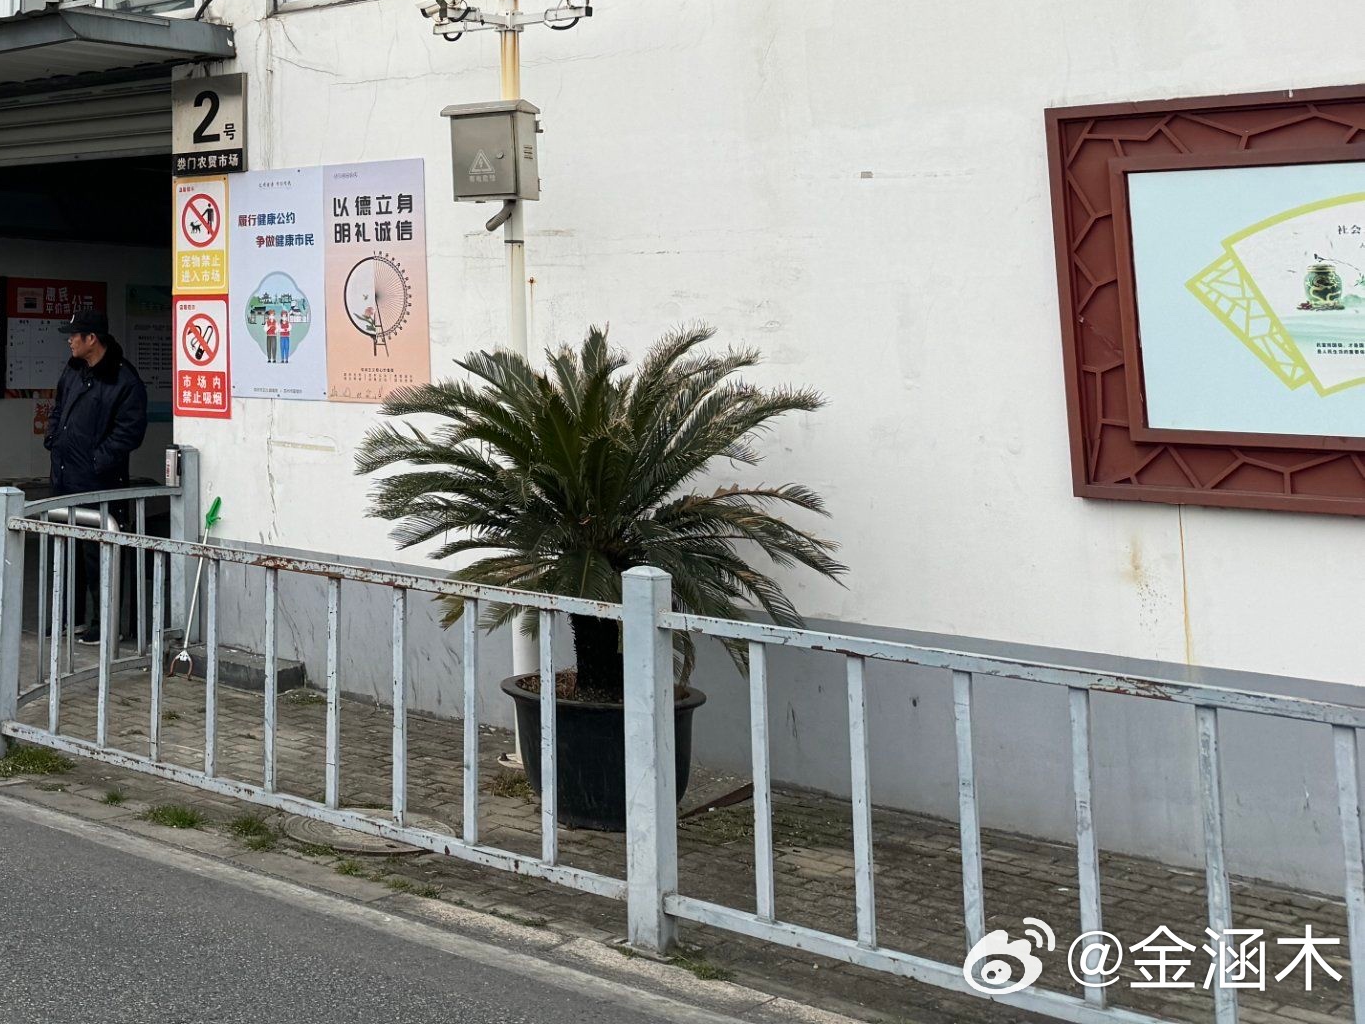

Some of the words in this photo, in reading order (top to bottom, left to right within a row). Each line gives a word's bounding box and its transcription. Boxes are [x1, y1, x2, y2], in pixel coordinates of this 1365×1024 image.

[177, 154, 239, 170] 娄门农贸市场
[333, 193, 413, 217] 以德立身
[238, 211, 296, 227] 履行健康公约
[334, 220, 413, 243] 明礼诚信
[255, 233, 315, 248] 争做健康市民
[181, 254, 221, 267] 宠物禁止
[181, 270, 221, 283] 进入市场
[182, 376, 222, 389] 市场内
[182, 390, 222, 406] 禁止吸烟
